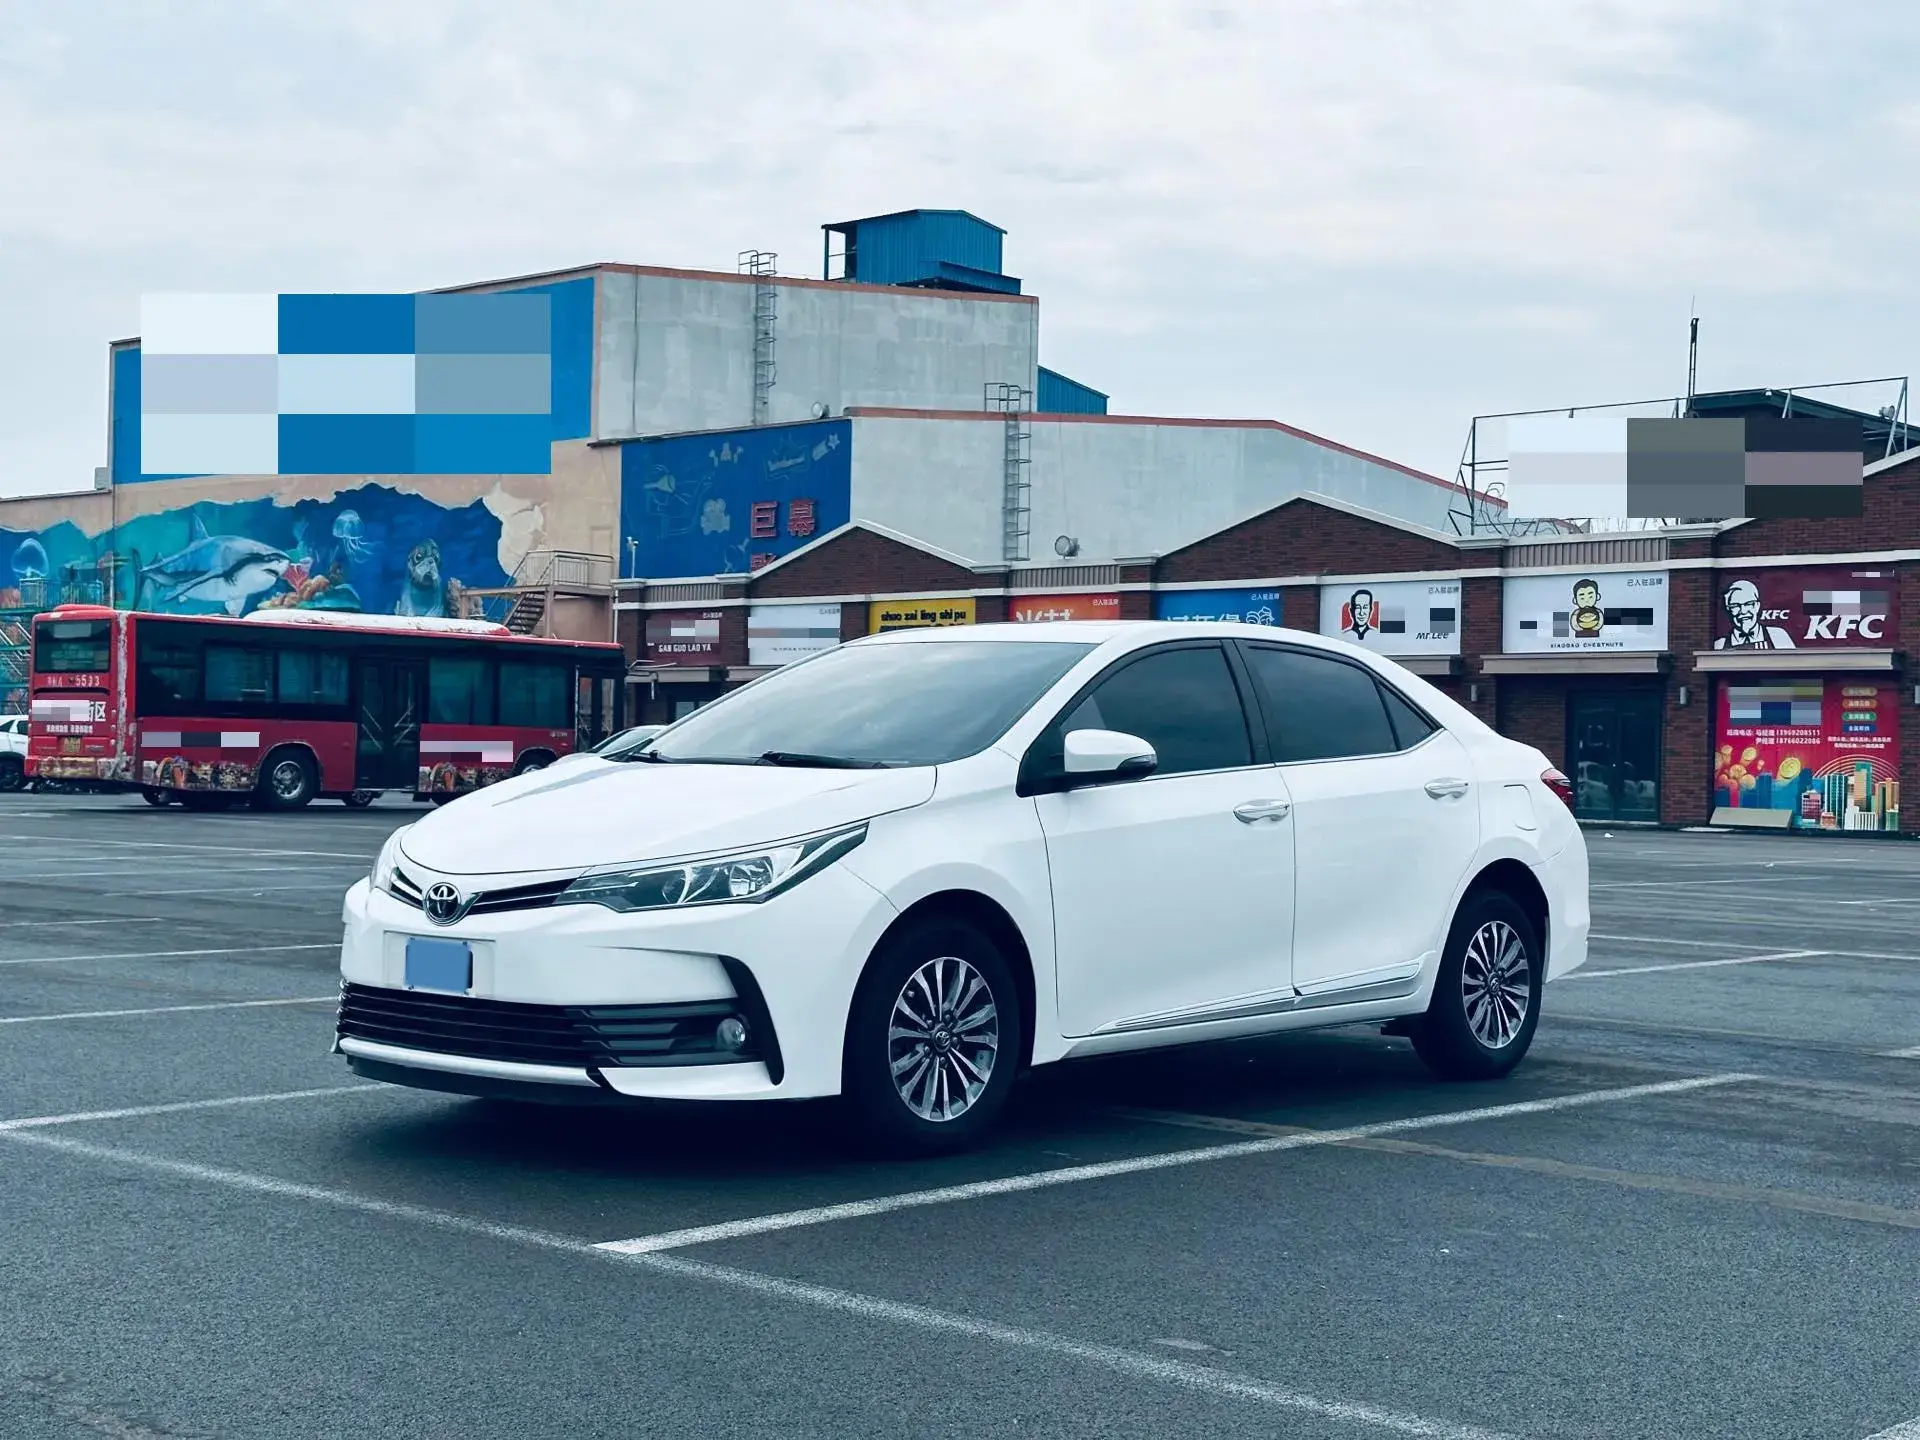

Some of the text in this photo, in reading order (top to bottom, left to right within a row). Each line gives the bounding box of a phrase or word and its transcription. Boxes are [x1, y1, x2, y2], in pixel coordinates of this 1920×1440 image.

[751, 498, 815, 538] 巨幕
[1760, 609, 1791, 620] KFC
[1803, 614, 1886, 640] KFC
[702, 643, 712, 652] YA
